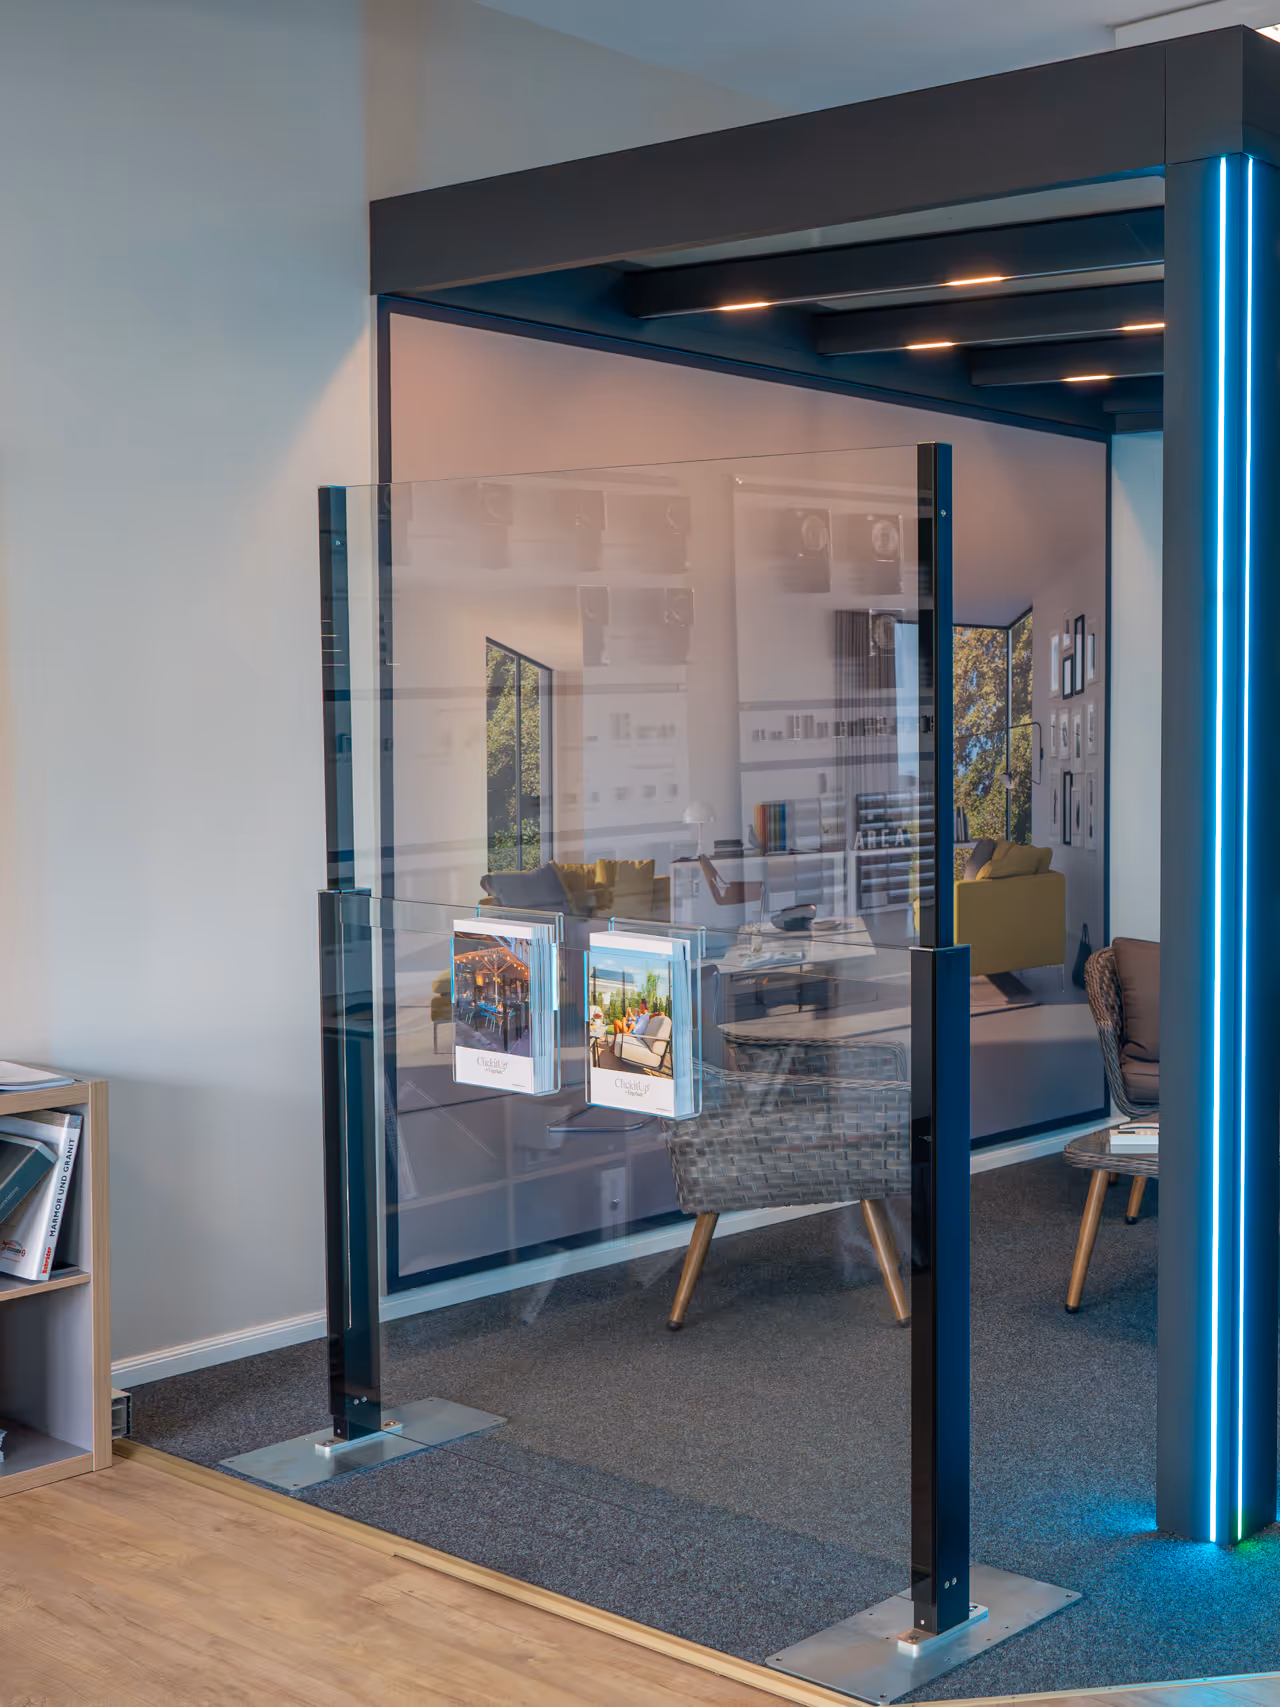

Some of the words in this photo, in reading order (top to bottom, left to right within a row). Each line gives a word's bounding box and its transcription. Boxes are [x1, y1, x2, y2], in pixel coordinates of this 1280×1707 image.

[49, 1197, 63, 1237] MARMOR
[58, 1175, 67, 1196] UND
[63, 1138, 75, 1173] GRANIT
